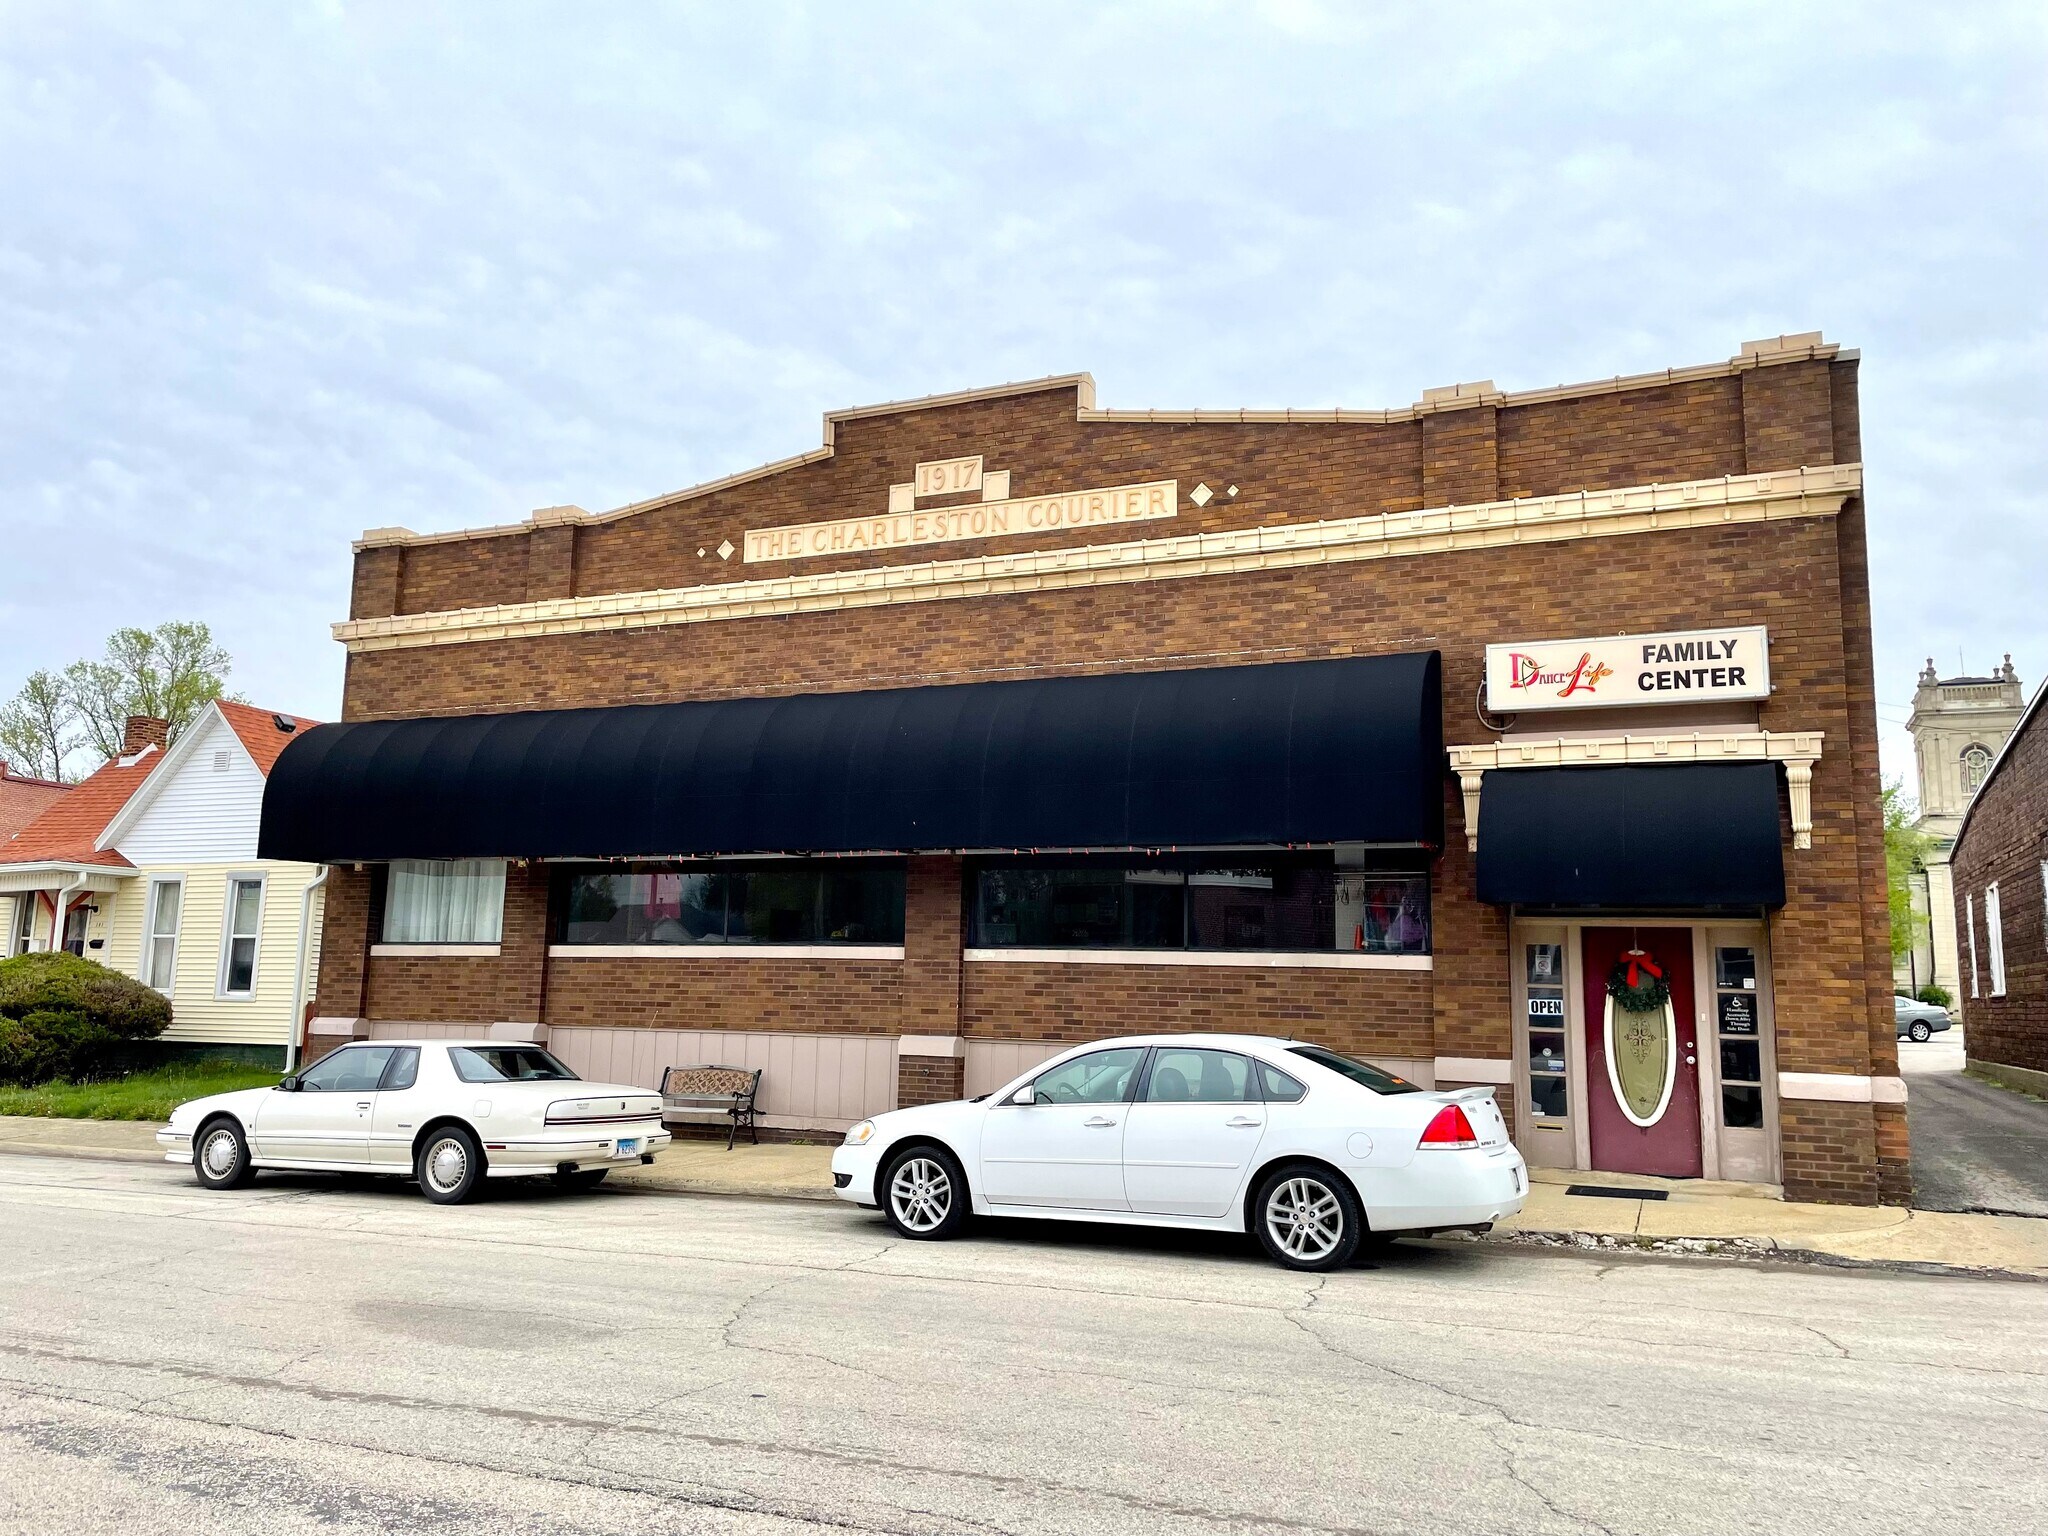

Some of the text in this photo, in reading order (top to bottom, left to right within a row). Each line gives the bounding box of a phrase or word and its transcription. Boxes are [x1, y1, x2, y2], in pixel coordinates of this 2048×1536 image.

[923, 461, 978, 492] 1917
[752, 488, 1168, 558] THE CHARLESTON COURIER
[1642, 639, 1738, 664] FAMILY
[1638, 666, 1746, 691] CENTER
[1531, 1000, 1562, 1014] OPEN
